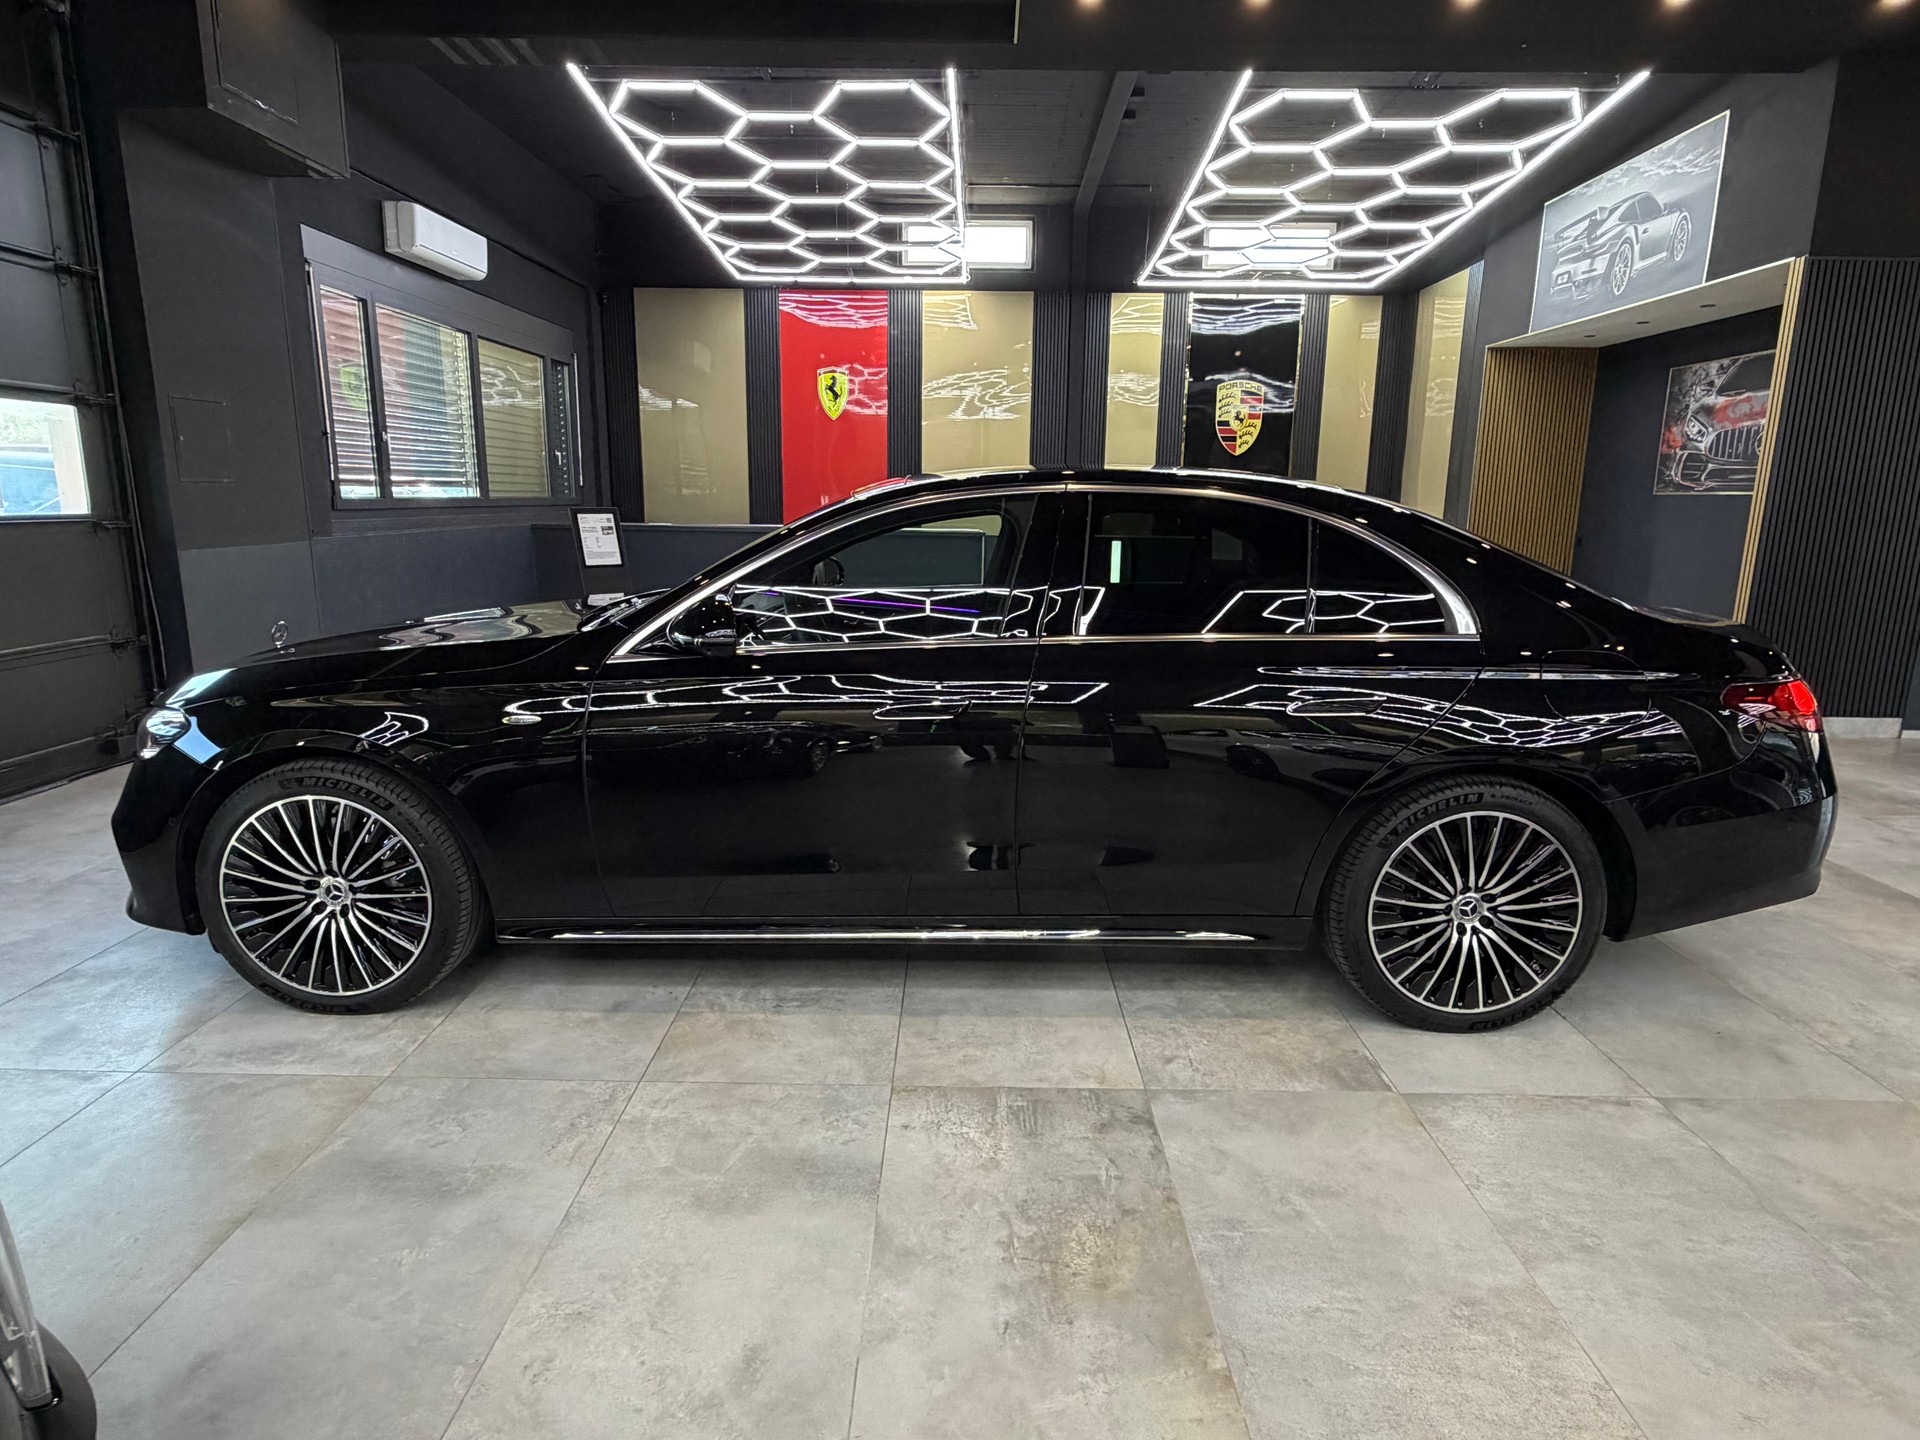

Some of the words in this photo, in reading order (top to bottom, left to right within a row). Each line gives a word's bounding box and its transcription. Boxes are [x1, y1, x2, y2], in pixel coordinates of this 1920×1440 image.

[1219, 381, 1263, 392] PORSCHE
[302, 777, 389, 808] MICHELIN
[1396, 793, 1479, 833] MICHELIN
